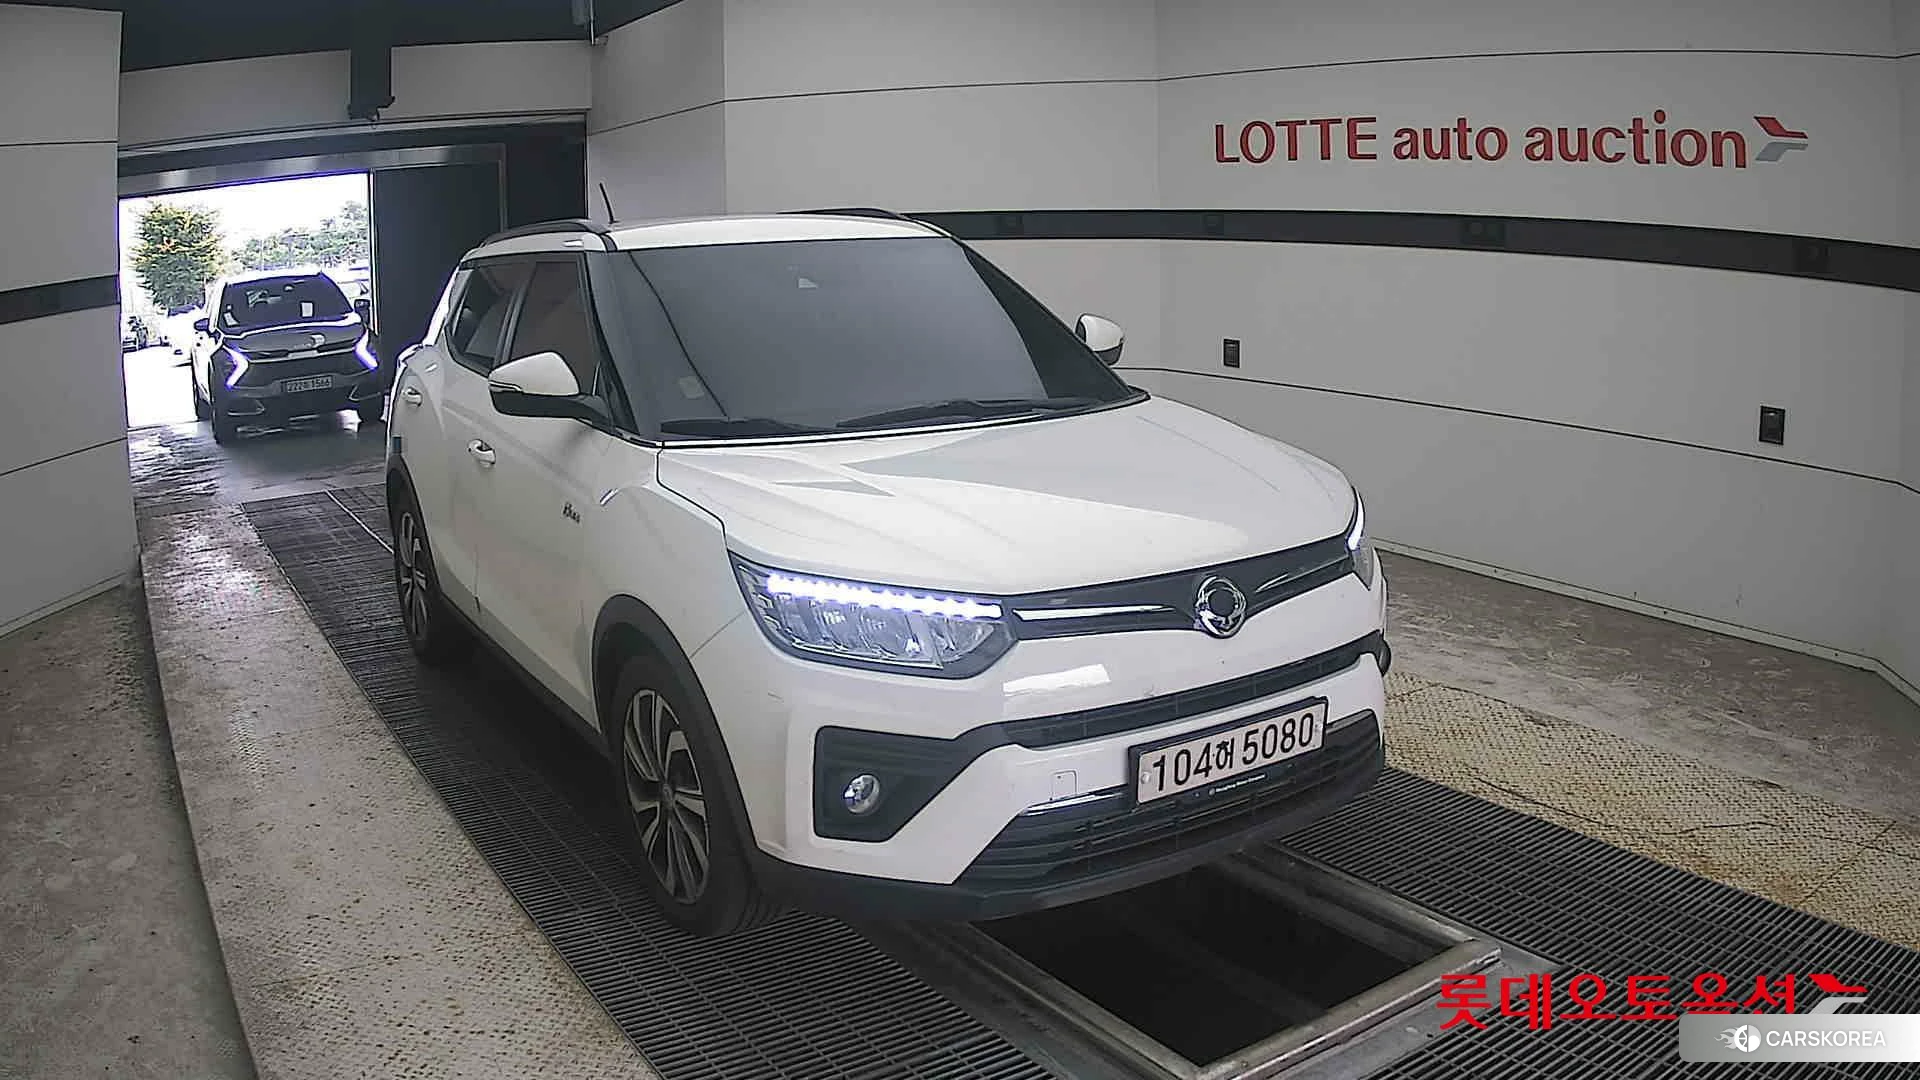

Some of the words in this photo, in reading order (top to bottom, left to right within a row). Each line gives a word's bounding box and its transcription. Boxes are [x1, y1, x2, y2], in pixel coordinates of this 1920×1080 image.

[1214, 117, 1377, 163] LOTTE
[1393, 117, 1509, 162] auto
[1524, 109, 1748, 169] auction
[1152, 738, 1235, 792] 104허
[1242, 713, 1314, 766] 5080
